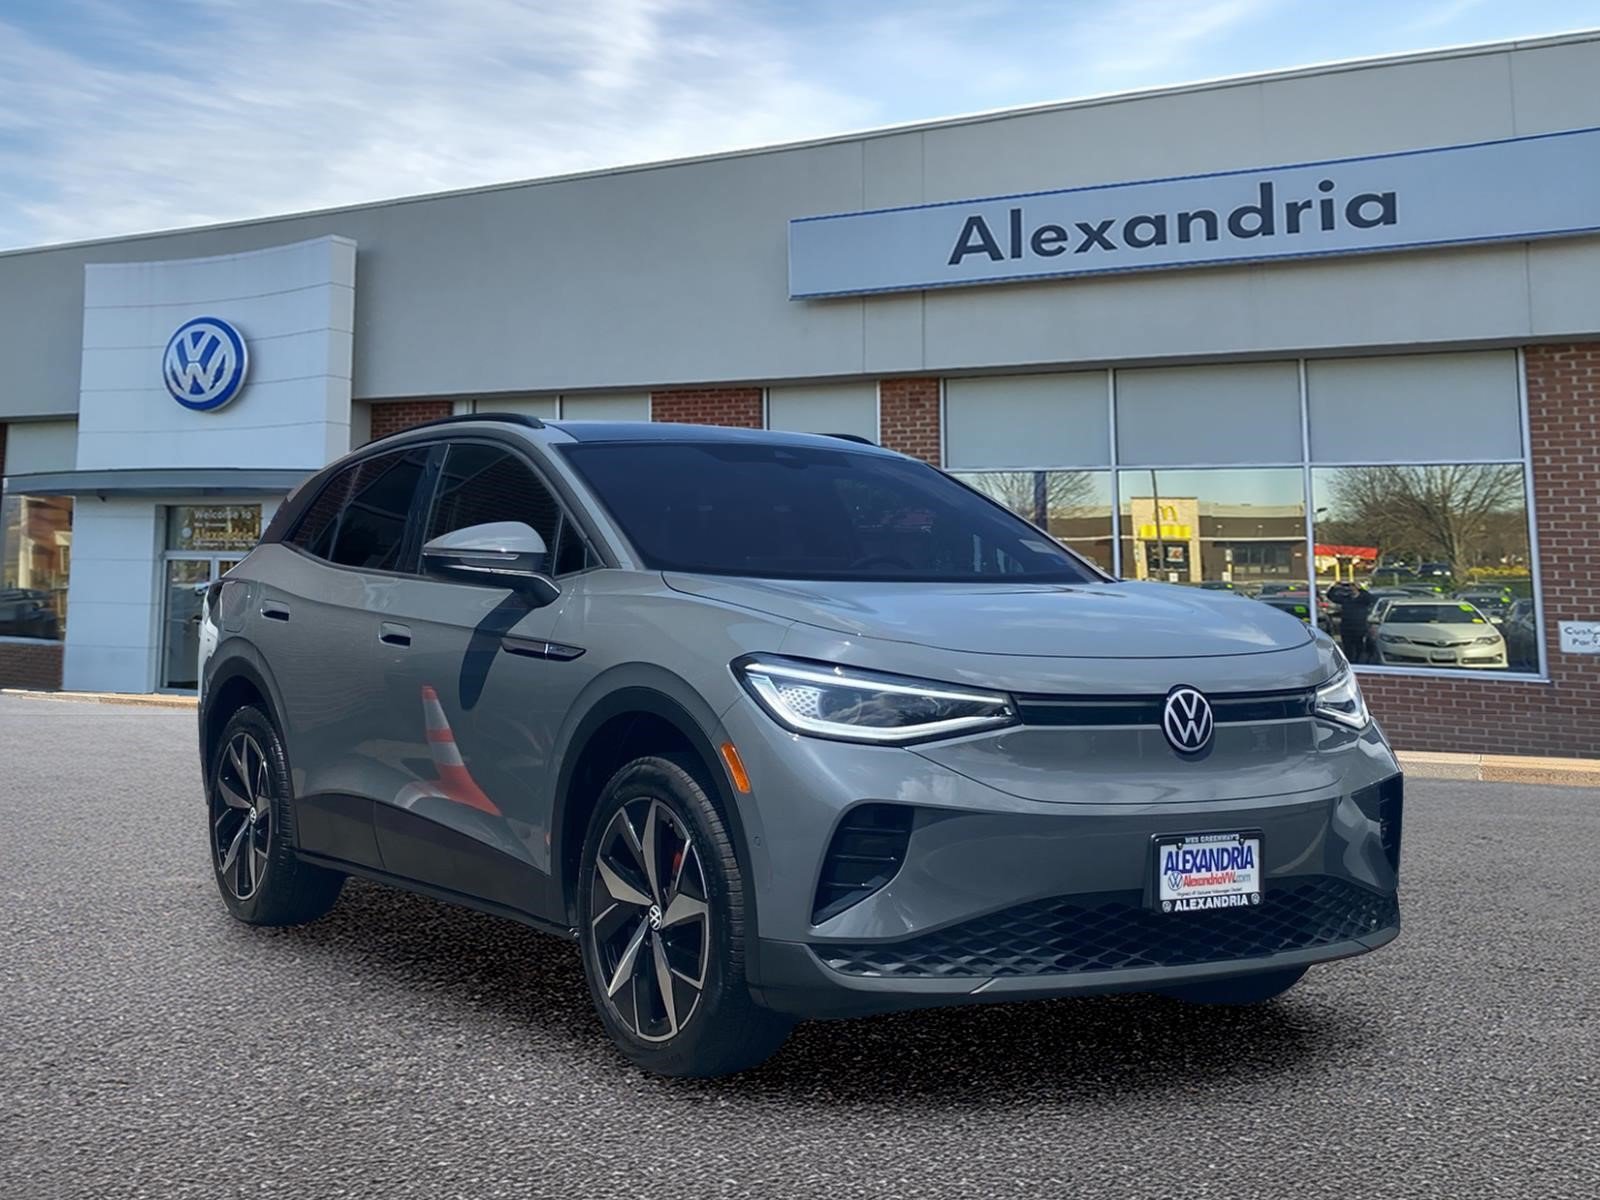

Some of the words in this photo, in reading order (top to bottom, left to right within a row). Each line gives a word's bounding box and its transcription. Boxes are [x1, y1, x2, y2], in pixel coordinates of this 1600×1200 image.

[948, 180, 1398, 266] Alexandria
[193, 510, 240, 520] Welcome
[1164, 688, 1213, 752] VW
[1164, 845, 1254, 875] ALEXANDRIA
[1174, 894, 1249, 912] ALEXANDRIA
